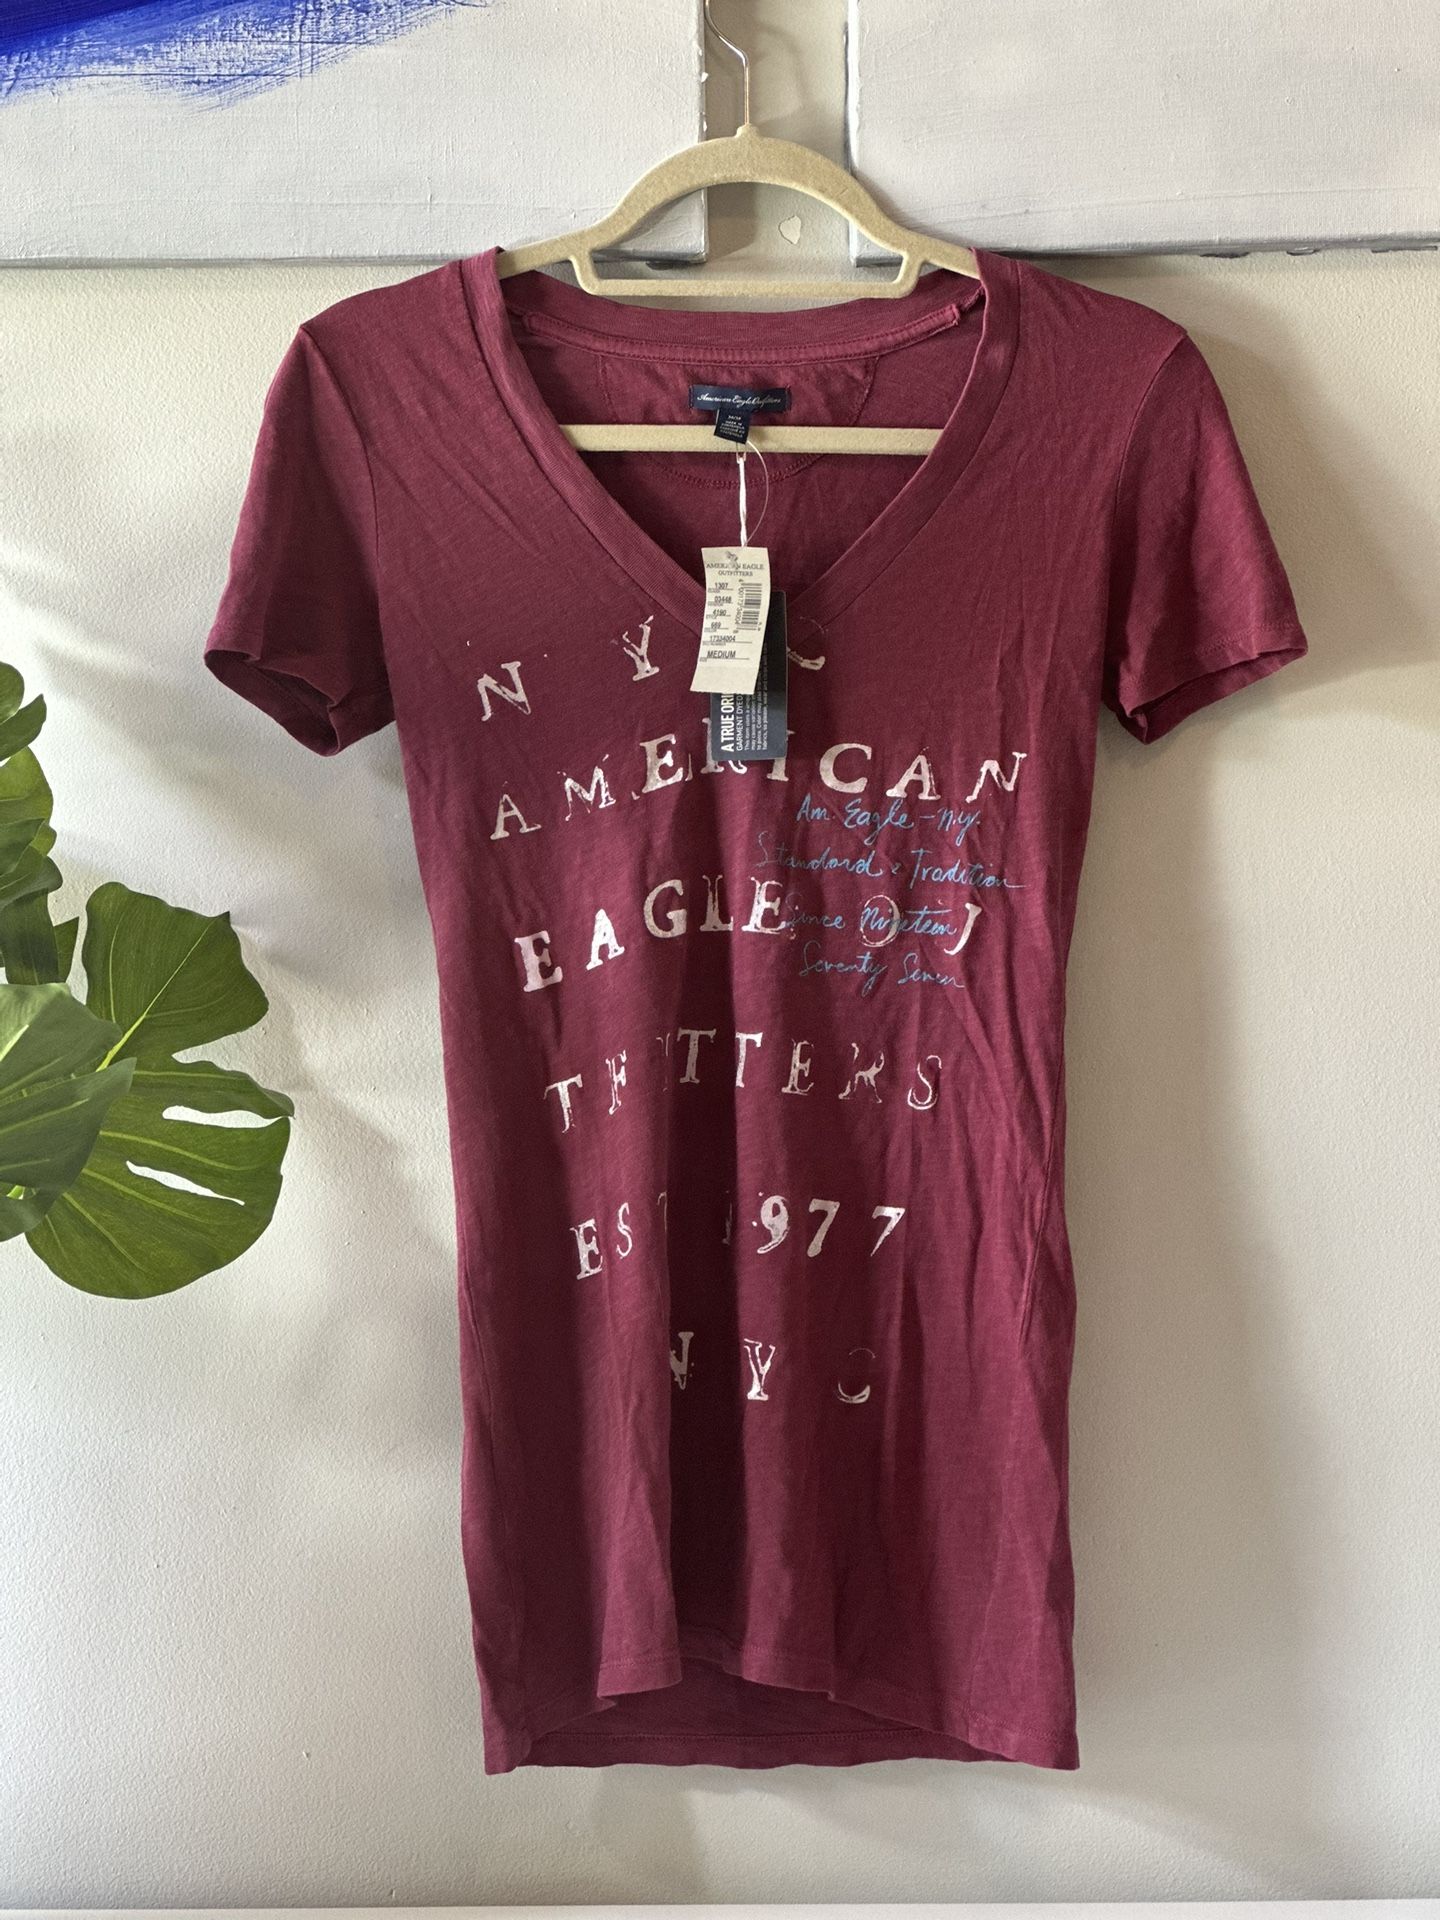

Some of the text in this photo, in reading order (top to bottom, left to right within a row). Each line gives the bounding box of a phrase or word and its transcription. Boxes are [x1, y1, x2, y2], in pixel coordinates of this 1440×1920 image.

[706, 650, 737, 659] MEDIUM
[721, 715, 735, 743] TRUE
[721, 742, 735, 753] A
[736, 695, 744, 751] GARMENT DYED
[844, 797, 915, 845] Eagle
[754, 831, 884, 877] Standard
[910, 848, 1028, 890] Tradition
[514, 874, 785, 993] EAGLE
[799, 940, 888, 997] Seventy
